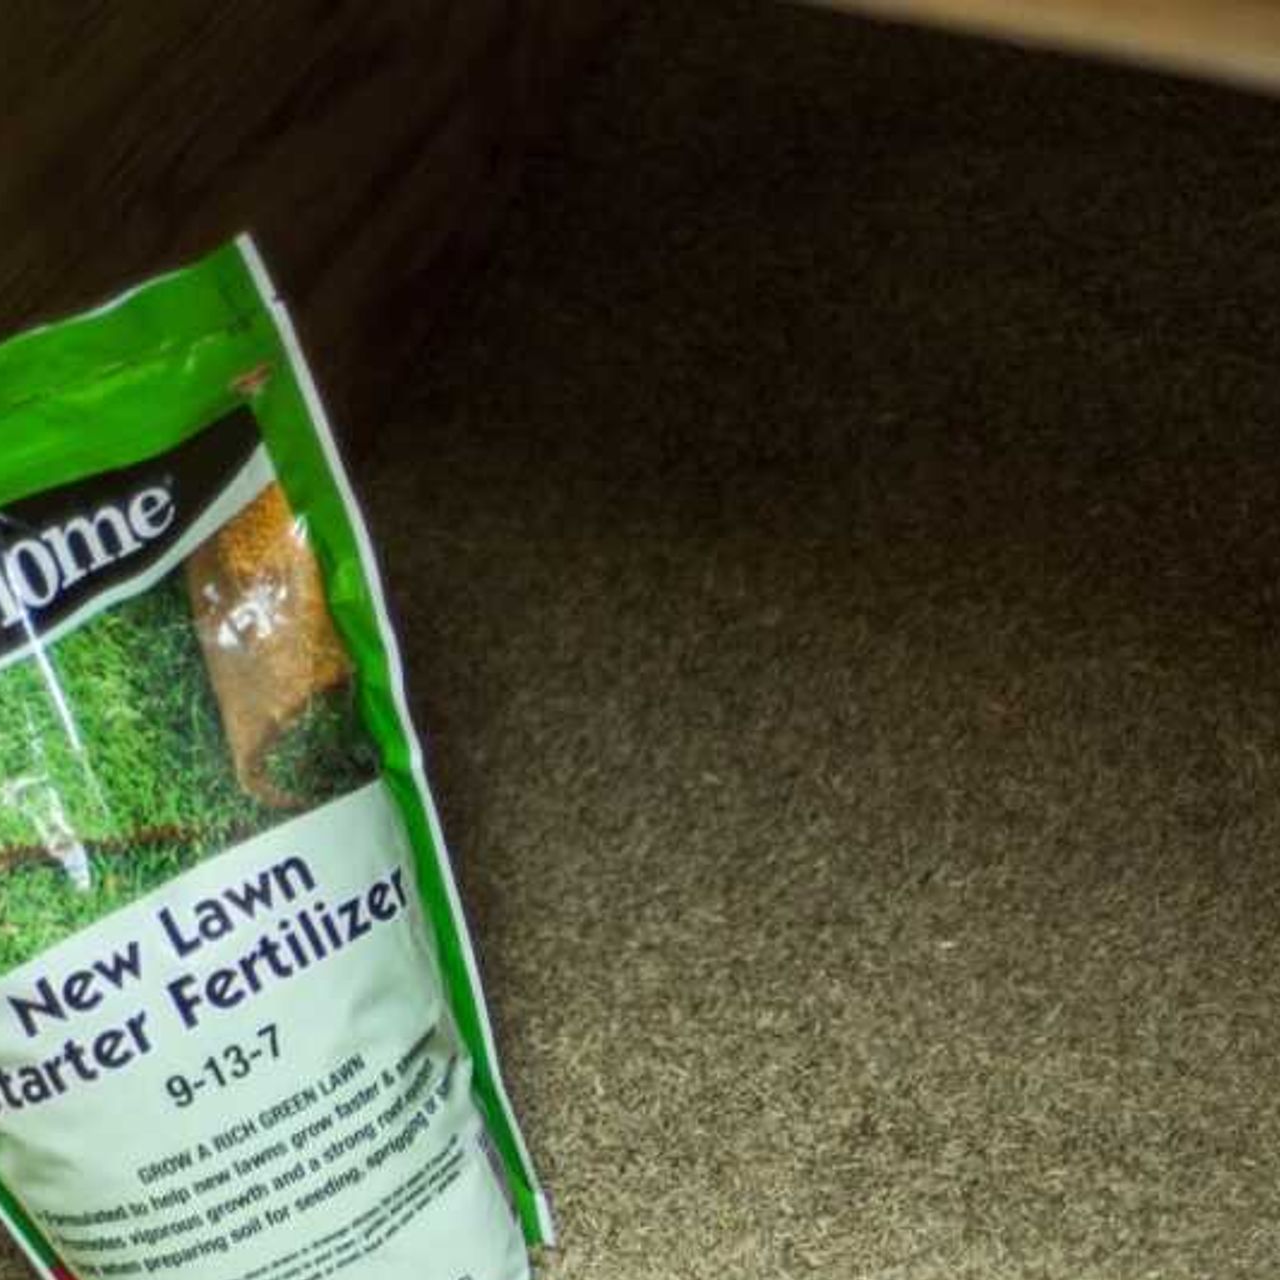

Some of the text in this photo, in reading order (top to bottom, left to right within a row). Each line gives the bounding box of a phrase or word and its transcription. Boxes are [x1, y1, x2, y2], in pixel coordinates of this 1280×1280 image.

[7, 854, 317, 1039] New Lawn
[166, 865, 408, 1031] Fertilizer
[137, 1150, 193, 1186] GROW
[197, 1143, 213, 1162] A
[212, 1117, 258, 1153] RICH
[258, 1086, 319, 1131] GREEN
[316, 1052, 366, 1098] LAWN
[166, 1023, 283, 1109] 9-13-7
[128, 1199, 150, 1217] to
[149, 1186, 192, 1211] help
[192, 1168, 231, 1197] new
[232, 1142, 288, 1177] lawns
[290, 1114, 334, 1151] grow
[334, 1081, 381, 1121] faster
[380, 1069, 396, 1088] &
[129, 1213, 205, 1246] vigorous
[206, 1181, 270, 1226] growth
[272, 1160, 306, 1192] and
[308, 1157, 322, 1172] a
[322, 1123, 378, 1164] strong
[142, 1235, 229, 1273] preparing
[229, 1218, 263, 1245] soil
[265, 1205, 292, 1228] for
[365, 1110, 430, 1170] sprigging
